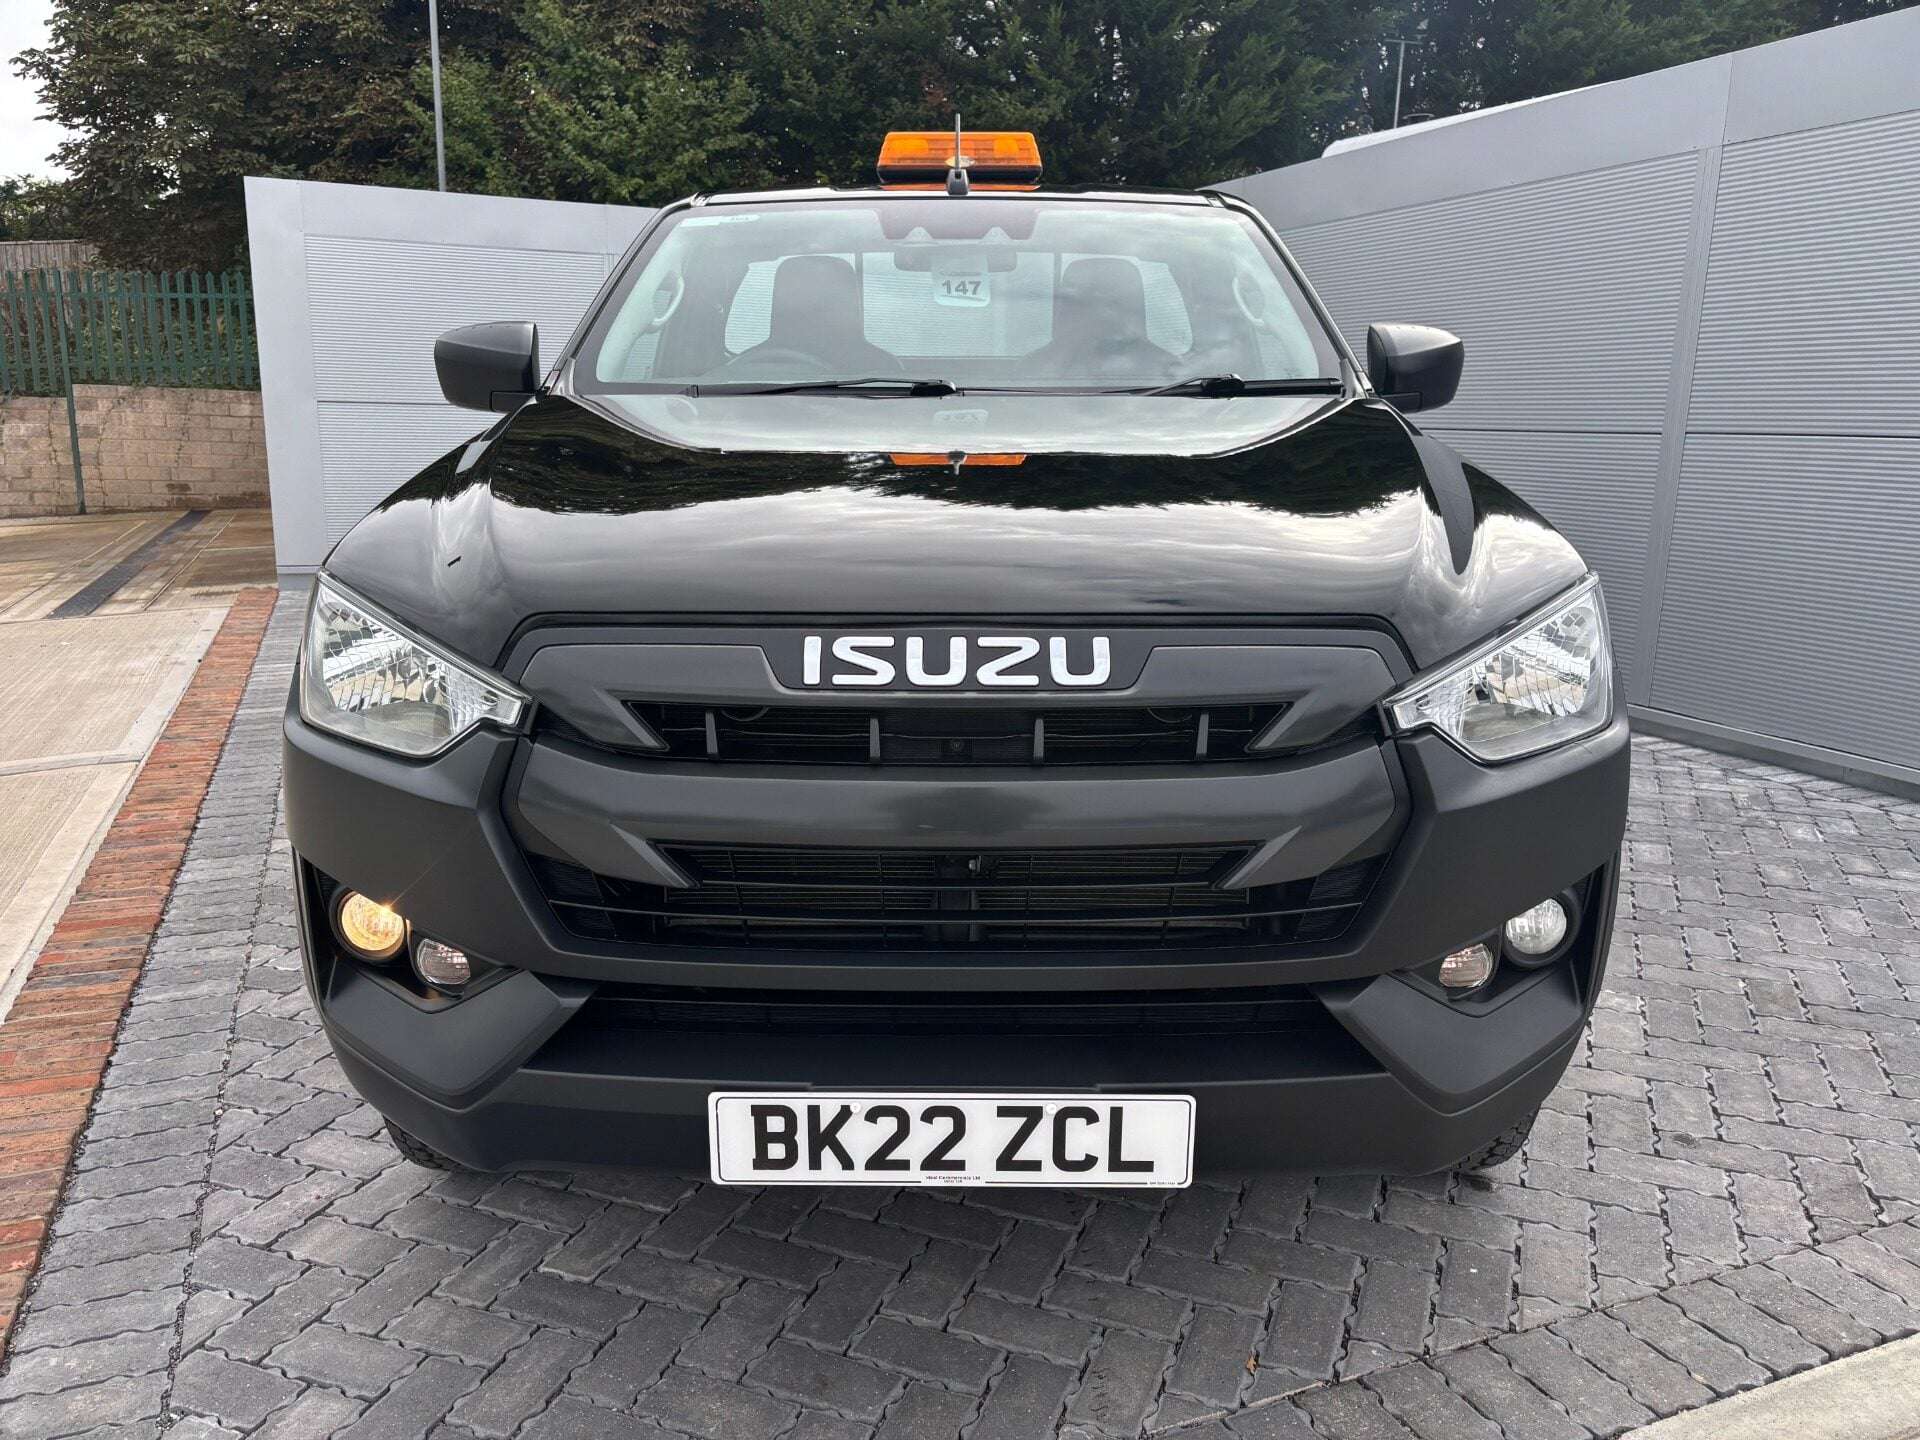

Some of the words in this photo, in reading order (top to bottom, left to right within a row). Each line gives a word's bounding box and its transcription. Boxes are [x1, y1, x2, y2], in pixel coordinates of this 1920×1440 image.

[941, 279, 982, 296] 147
[803, 635, 1111, 686] ISUZU
[750, 1104, 967, 1172] BK22
[995, 1105, 1155, 1173] ZCL
